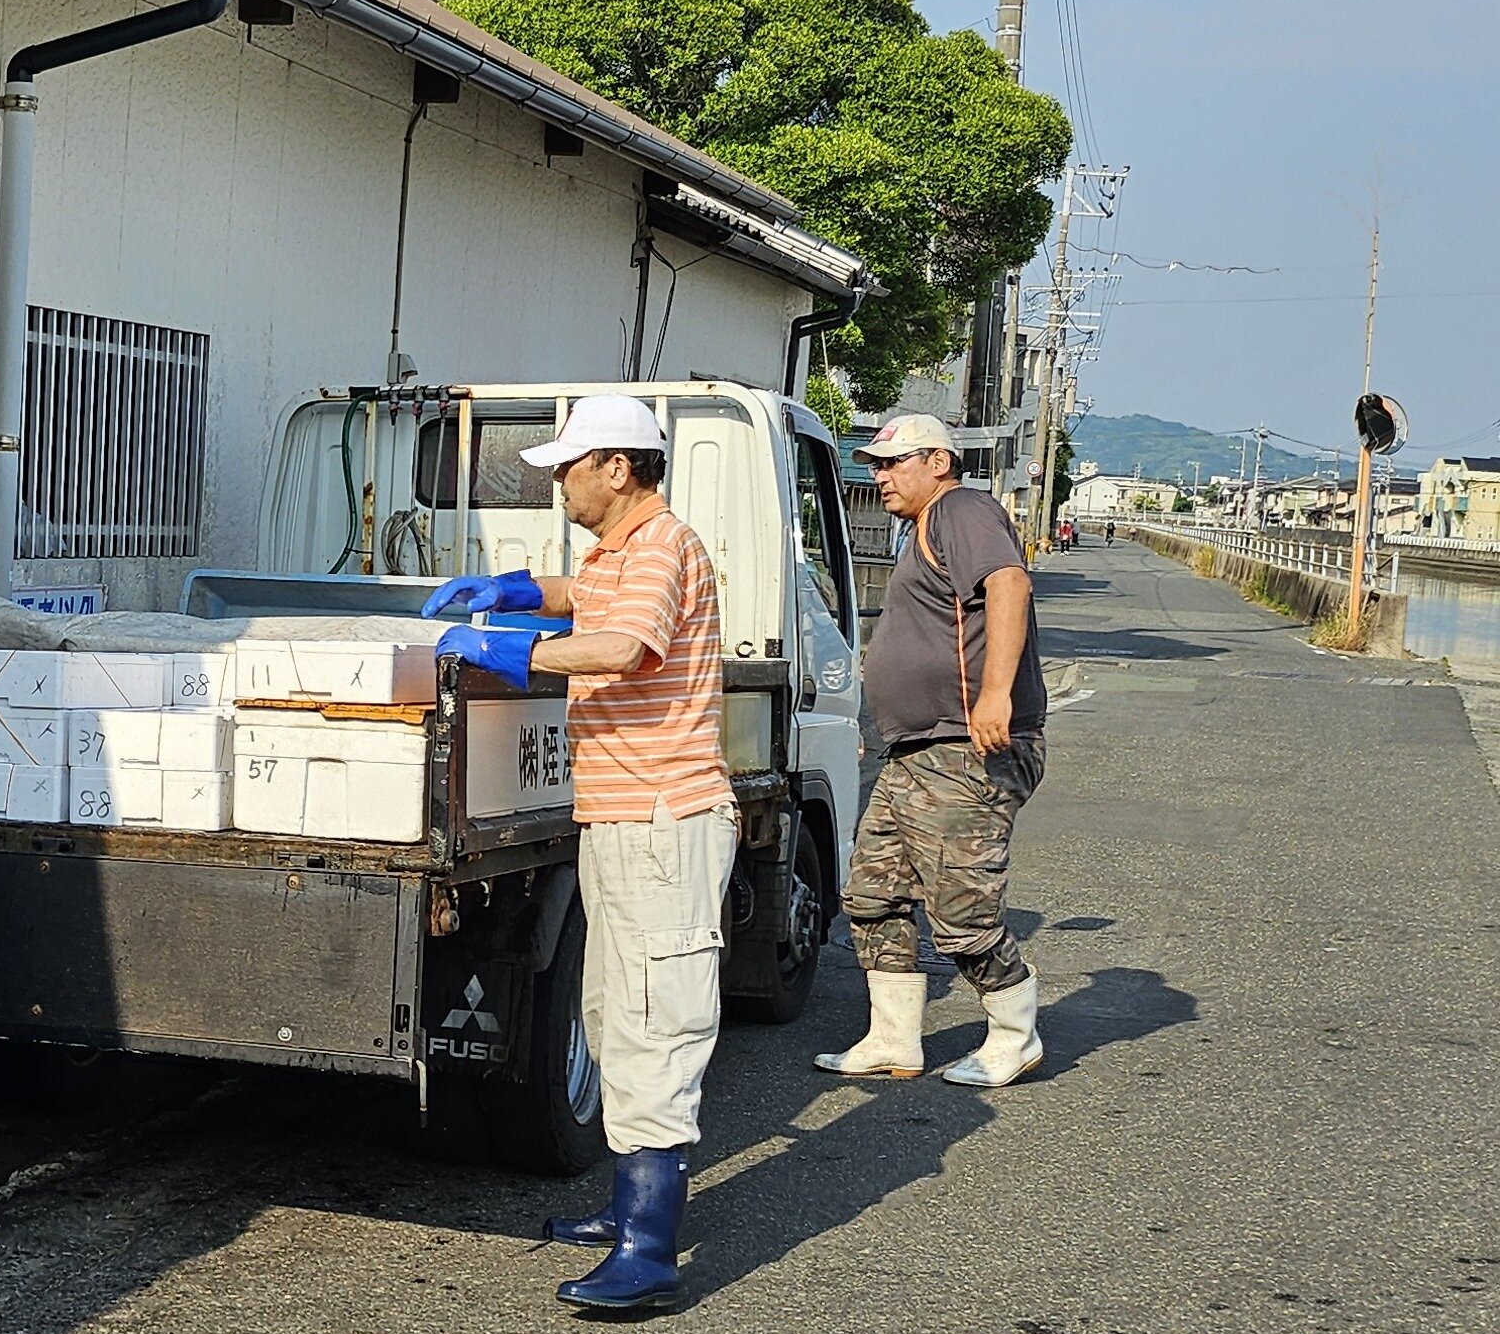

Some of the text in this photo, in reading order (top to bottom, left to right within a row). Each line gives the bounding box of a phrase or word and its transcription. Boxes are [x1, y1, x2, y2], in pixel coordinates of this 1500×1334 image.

[181, 673, 210, 697] 88
[78, 729, 106, 763] 37
[248, 759, 278, 783] 57
[78, 790, 112, 818] 88
[428, 1036, 510, 1063] FUSO
